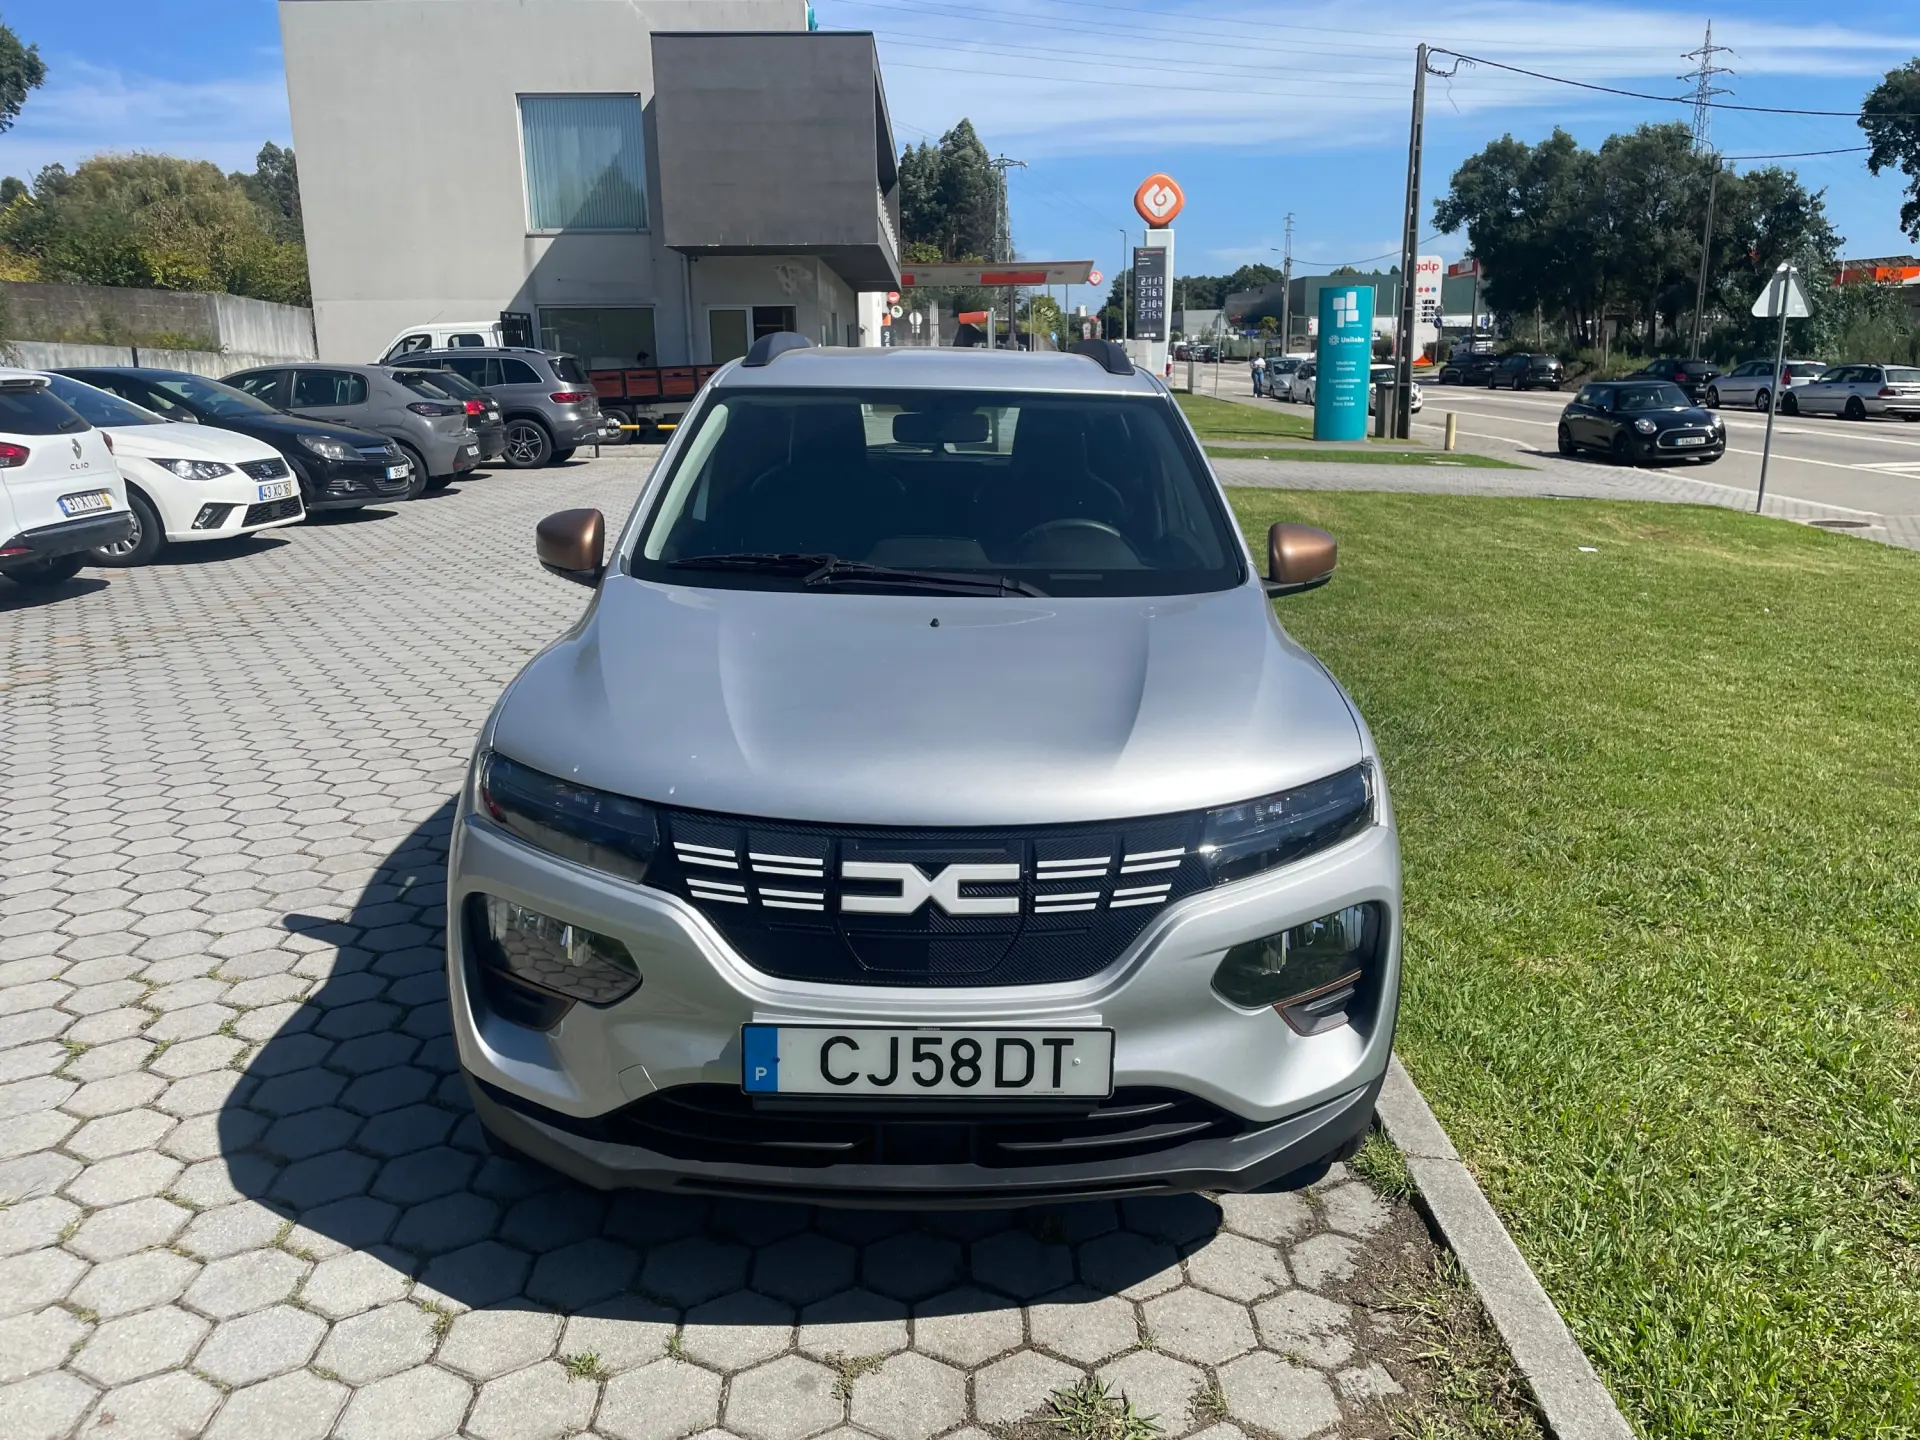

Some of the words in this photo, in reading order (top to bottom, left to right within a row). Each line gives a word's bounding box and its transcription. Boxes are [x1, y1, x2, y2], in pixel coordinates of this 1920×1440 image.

[1416, 260, 1440, 274] galp
[69, 462, 90, 471] CLIO
[754, 1066, 768, 1081] P
[819, 1035, 1075, 1089] CJ58DT
